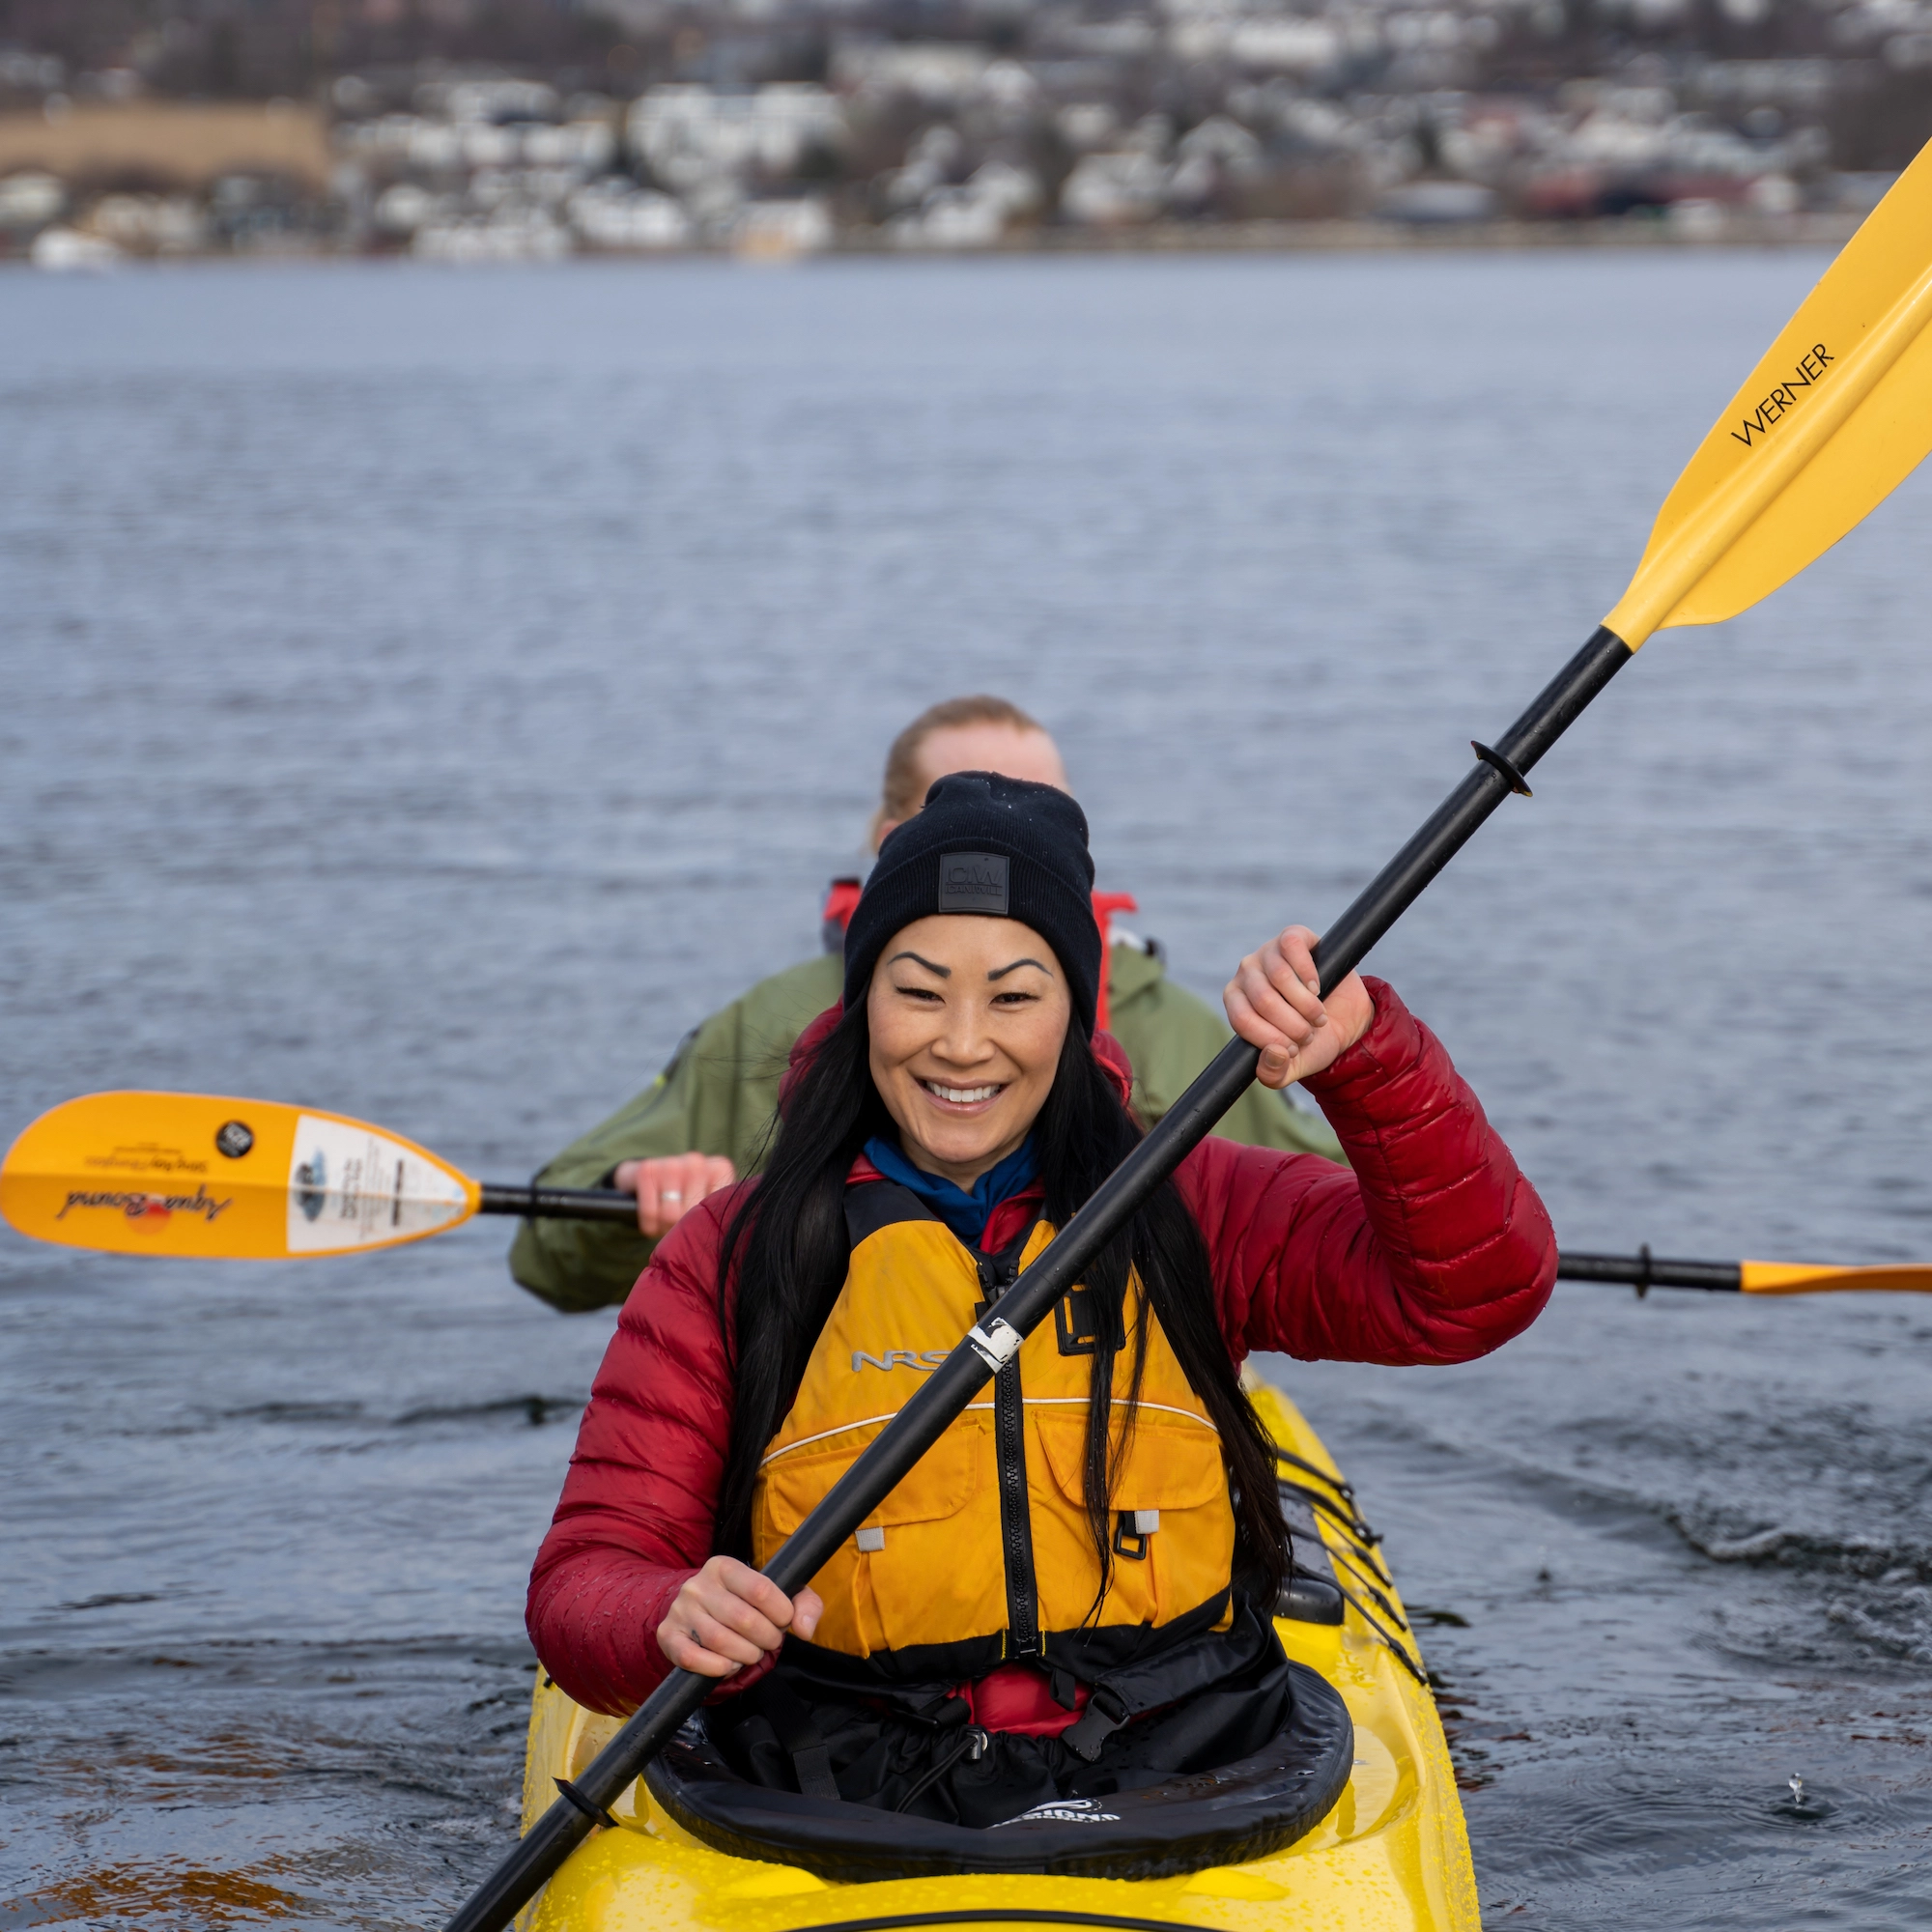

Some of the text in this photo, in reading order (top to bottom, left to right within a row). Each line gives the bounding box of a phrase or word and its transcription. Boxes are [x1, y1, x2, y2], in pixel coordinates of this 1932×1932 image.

[1730, 343, 1834, 446] WERNER
[56, 1183, 232, 1222] Aqua Bound
